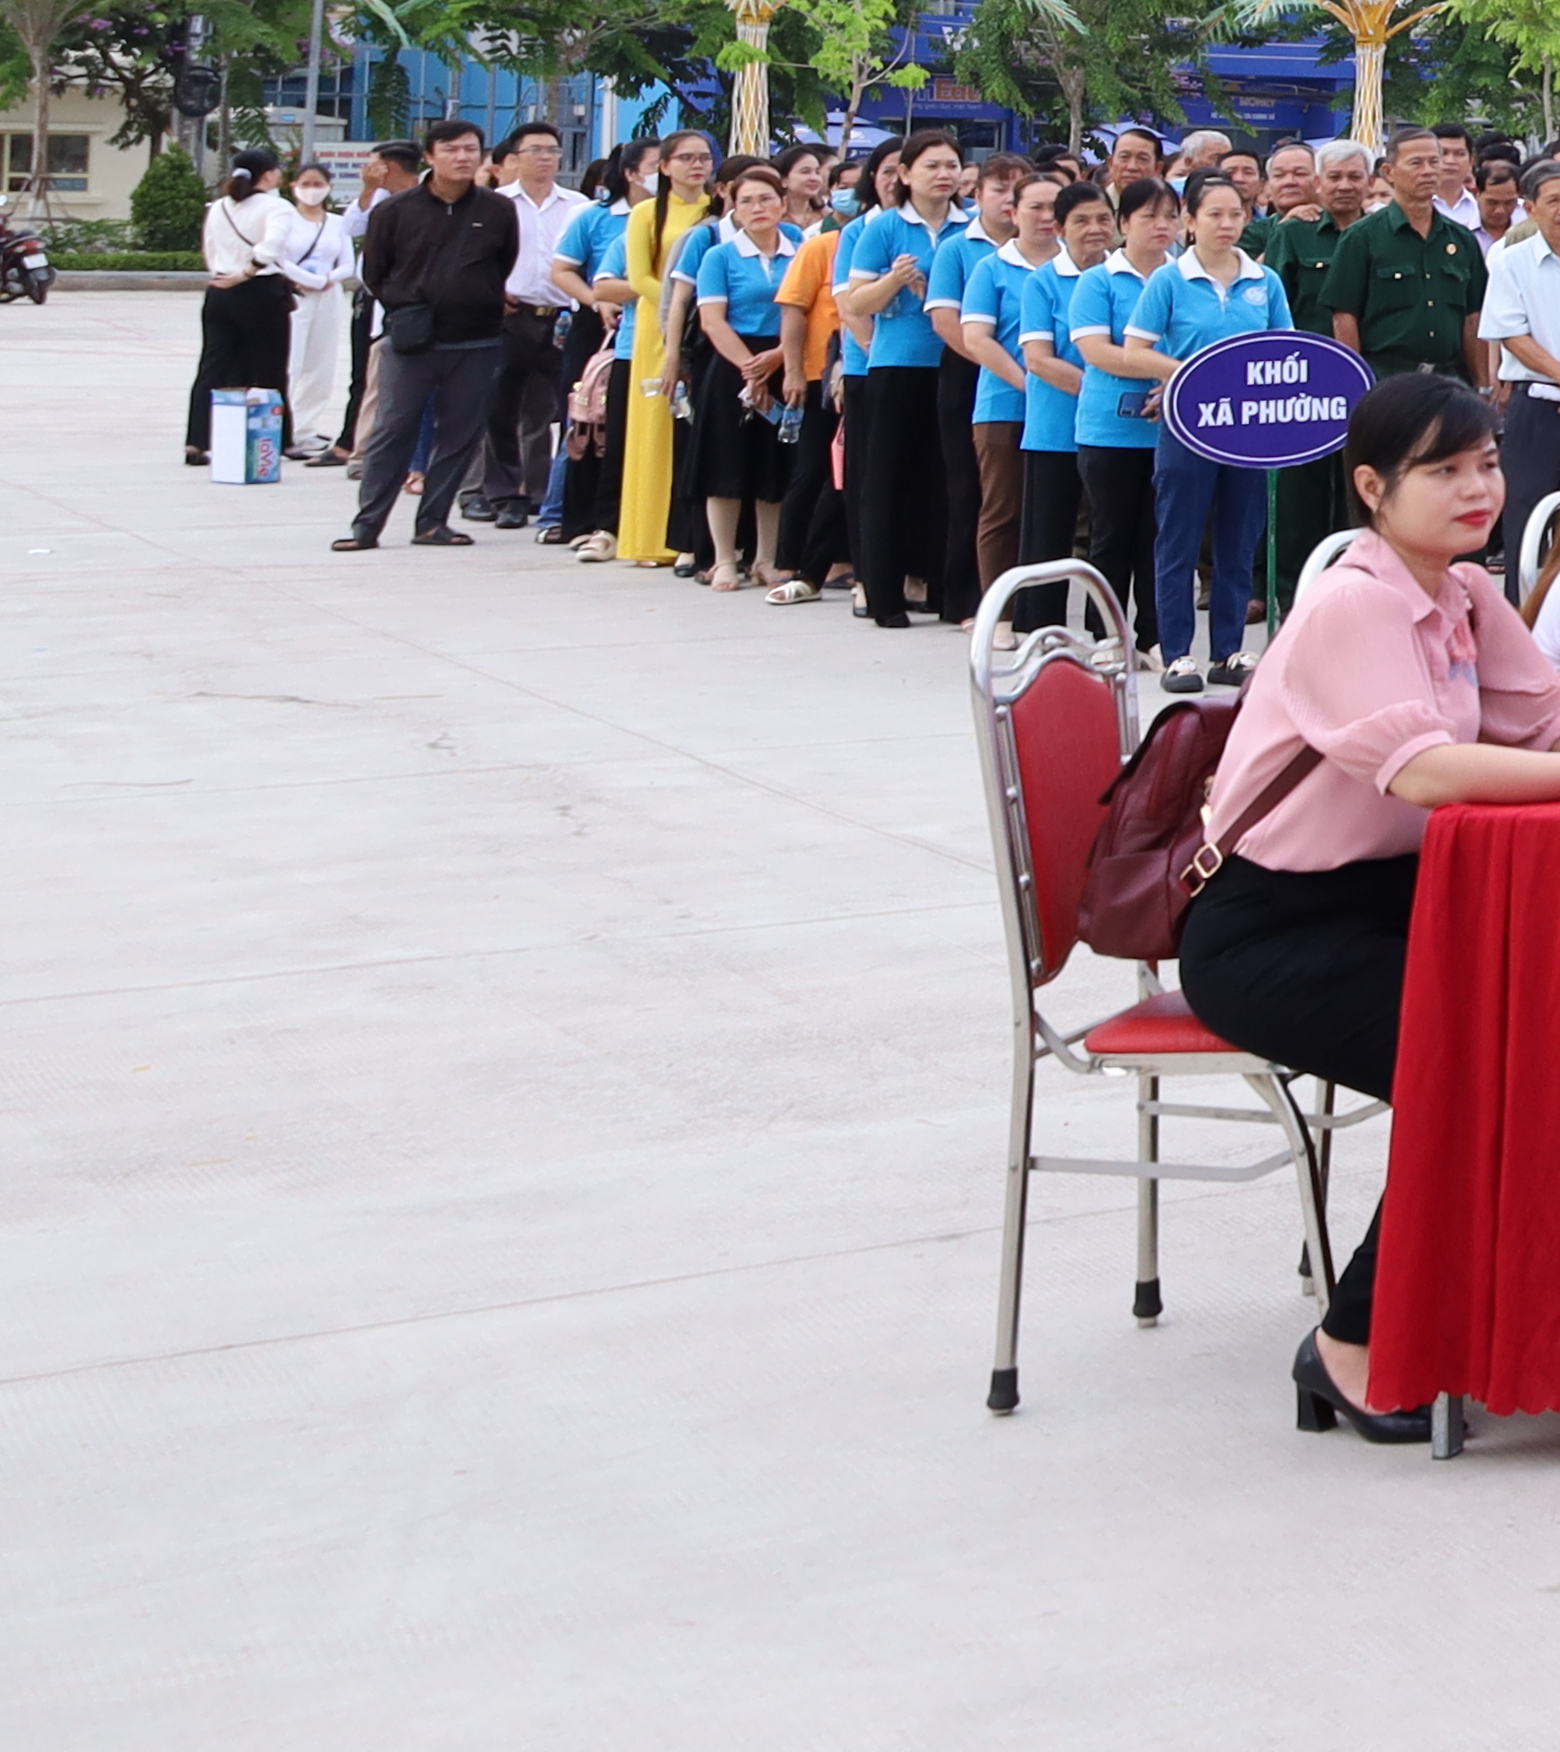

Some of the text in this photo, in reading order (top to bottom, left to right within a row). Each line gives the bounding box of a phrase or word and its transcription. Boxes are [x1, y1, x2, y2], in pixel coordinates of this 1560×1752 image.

[1247, 351, 1308, 385] KHỐI
[1197, 392, 1347, 427] XÃ PHƯỜNG
